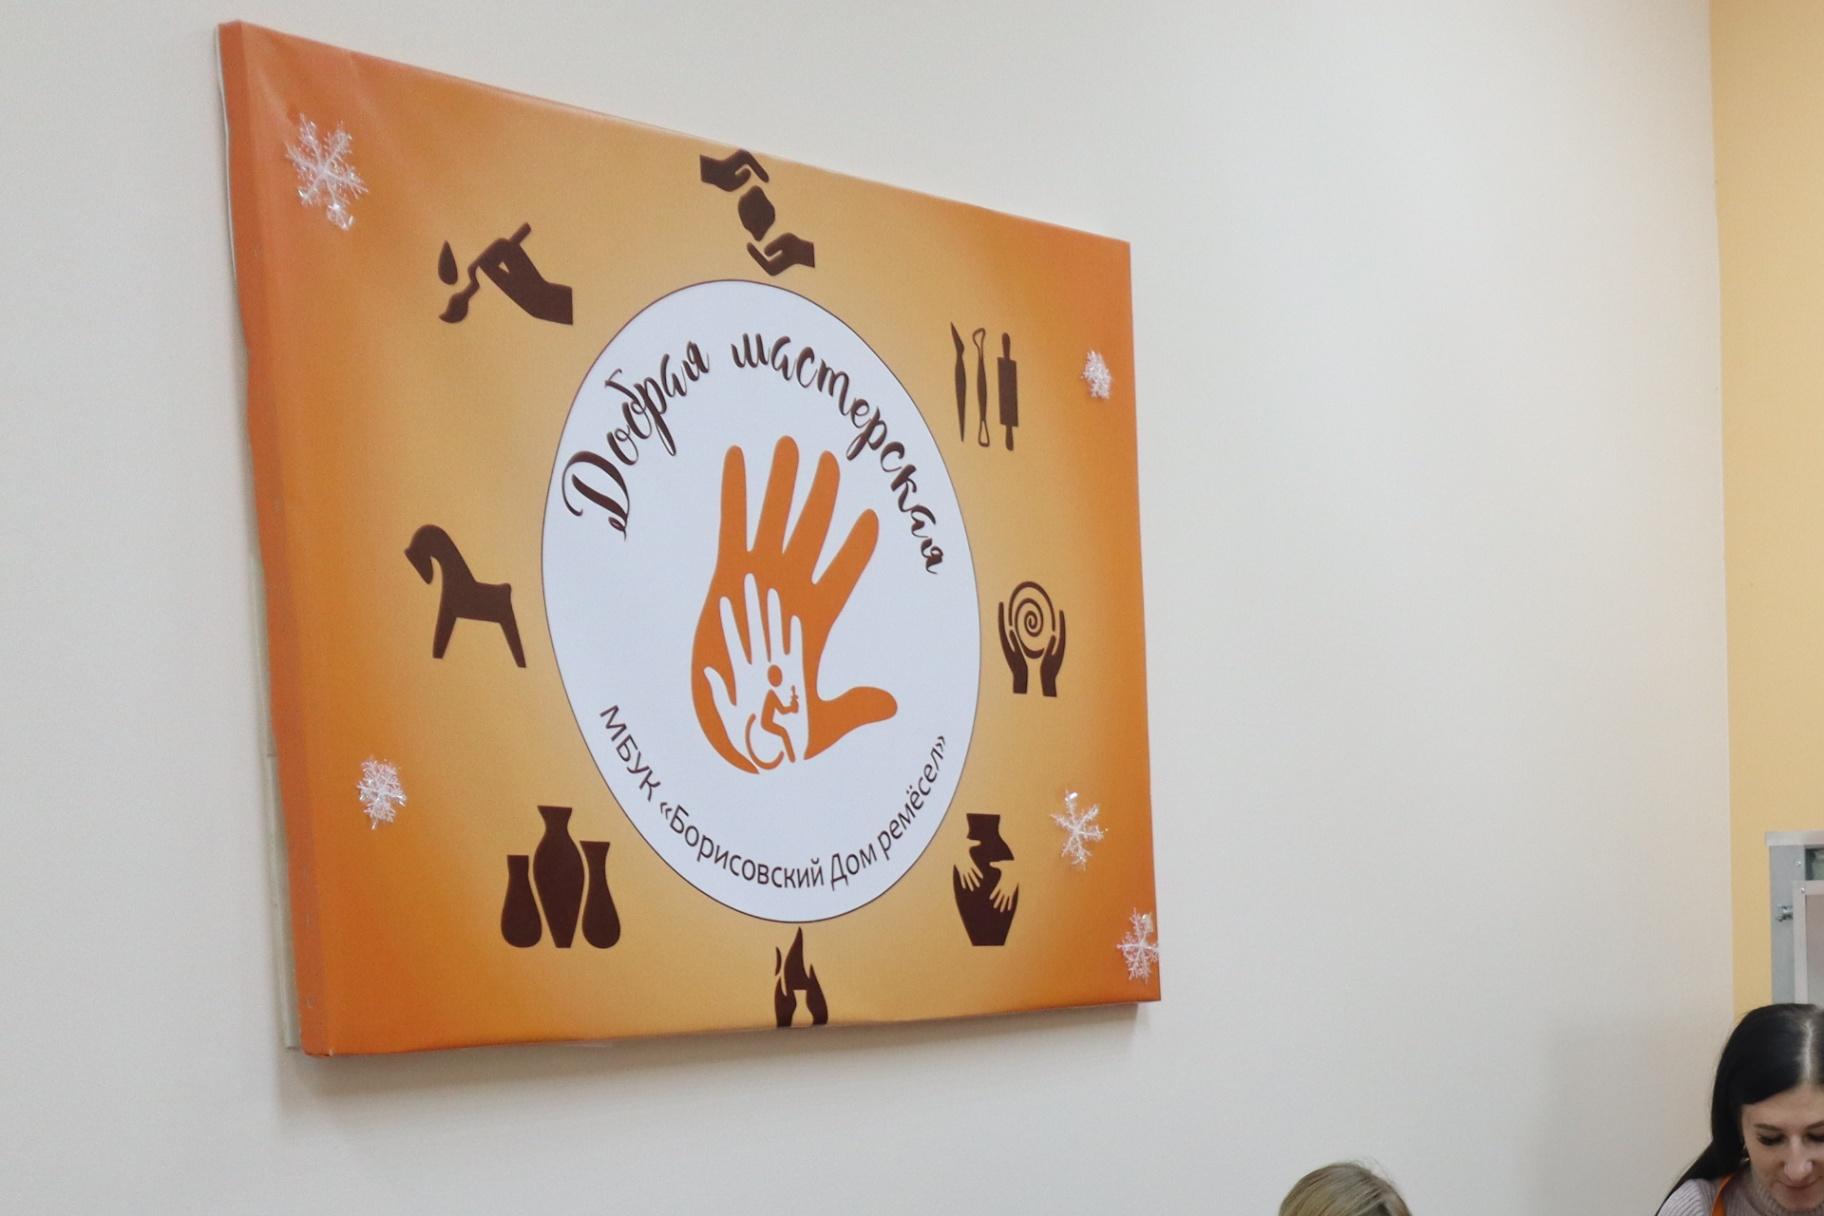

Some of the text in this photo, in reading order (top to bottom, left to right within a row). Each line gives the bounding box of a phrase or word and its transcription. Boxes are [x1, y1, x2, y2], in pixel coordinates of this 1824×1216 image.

[562, 333, 944, 574] Добрая мастерская
[600, 705, 946, 891] МБУК «Борисовский Дом ремёсел»
